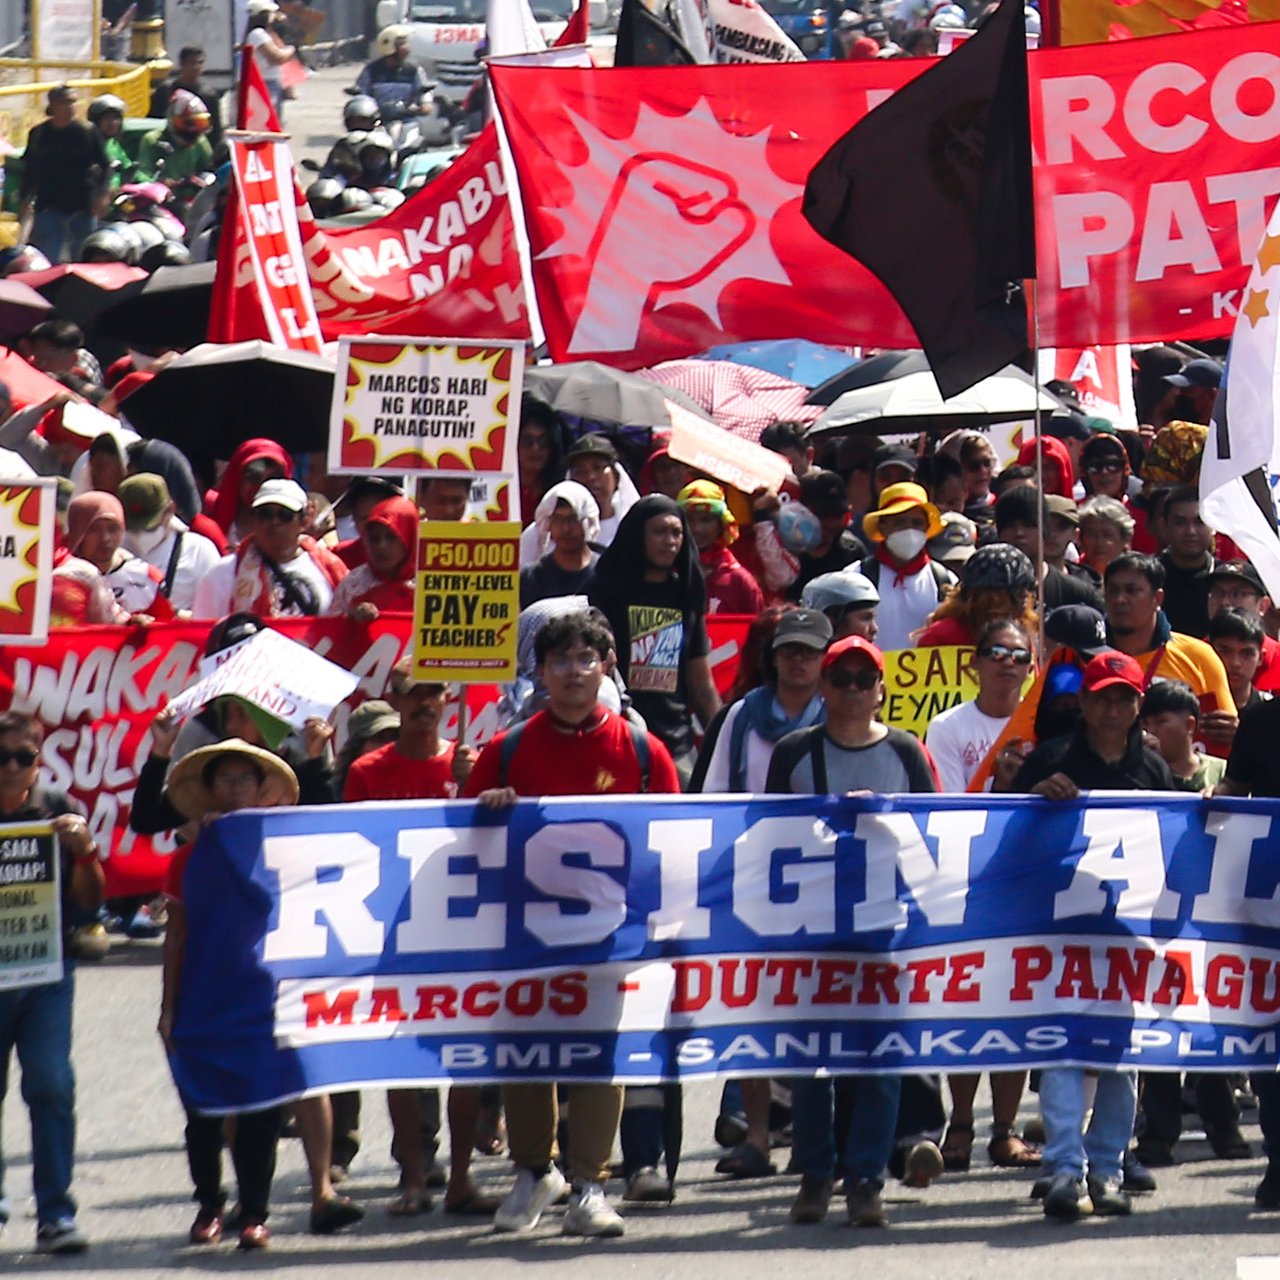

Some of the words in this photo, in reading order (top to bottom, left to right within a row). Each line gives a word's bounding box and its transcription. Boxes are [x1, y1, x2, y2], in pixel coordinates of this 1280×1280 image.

[367, 374, 441, 395] MARCOS
[446, 378, 487, 397] HARI
[381, 396, 405, 416] NG
[409, 397, 471, 421] KORAP,
[372, 418, 475, 441] PANAGUTIN!
[425, 542, 515, 569] P50,000
[423, 574, 515, 591] ENTRY-LEVEL
[422, 594, 480, 625] PAY
[481, 602, 509, 619] FOR
[420, 622, 513, 647] TEACHERS
[894, 648, 980, 688] SAR
[262, 809, 989, 963] RESIGN
[302, 970, 589, 1029] MARCOS
[670, 949, 988, 1012] DUTERTE
[441, 1041, 602, 1071] BMP
[676, 1025, 1068, 1066] SANLAKAS
[1129, 1026, 1278, 1058] PLM
